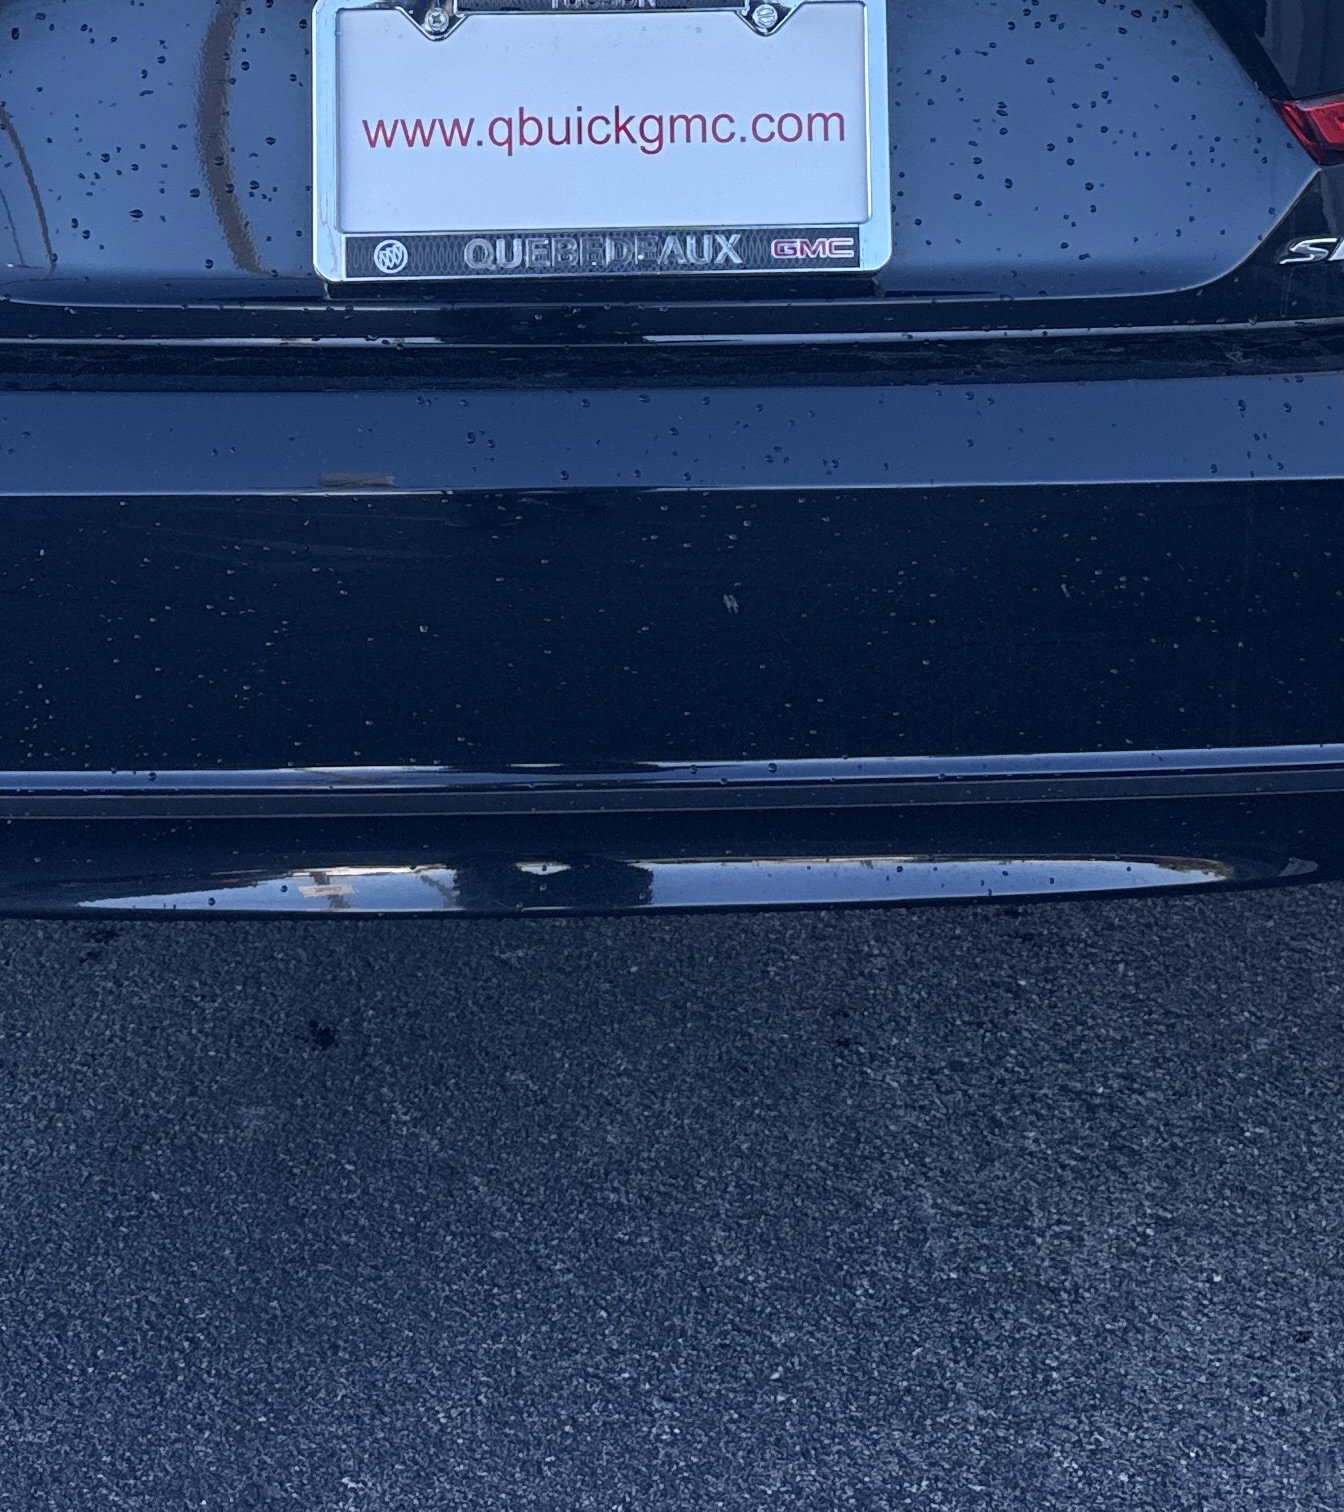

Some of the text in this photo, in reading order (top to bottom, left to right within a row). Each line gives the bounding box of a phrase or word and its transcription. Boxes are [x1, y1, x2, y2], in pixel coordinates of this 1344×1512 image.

[361, 105, 846, 156] www.qbuickgmc.com
[463, 233, 855, 271] QUEBEDEAUX GMC
